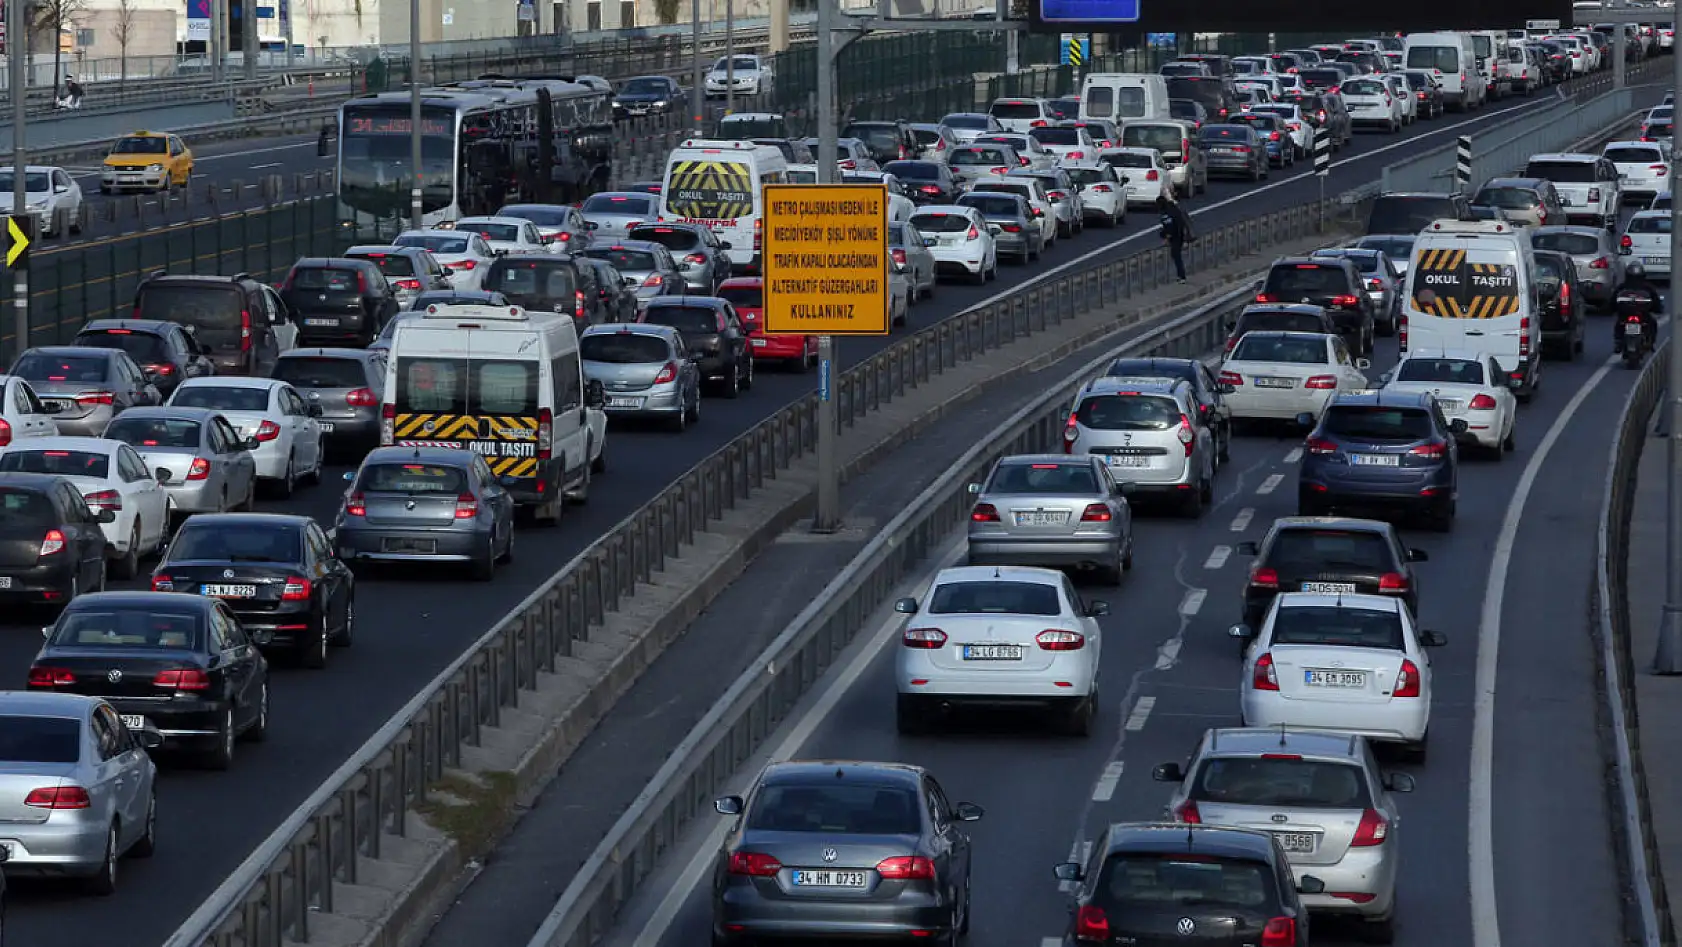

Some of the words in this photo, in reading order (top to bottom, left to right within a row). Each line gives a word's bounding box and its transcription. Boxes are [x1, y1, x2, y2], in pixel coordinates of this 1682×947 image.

[679, 191, 704, 200] OKUL
[772, 201, 798, 215] METRO
[799, 201, 837, 220] ÇALIŞMASI
[848, 225, 878, 241] YÖNÜNE
[801, 253, 827, 268] KAPALI
[828, 250, 878, 268] OLACAĞINDAN
[1425, 275, 1460, 284] OKUL
[1472, 276, 1512, 288] TAŞITI
[791, 304, 854, 319] KULLANINIZ
[469, 441, 498, 456] OKUL
[501, 442, 534, 459] TAŞITI
[206, 584, 217, 595] 34
[969, 646, 980, 657] 34
[1311, 673, 1322, 683] 34
[799, 871, 812, 883] 34
[836, 873, 864, 885] 0733
